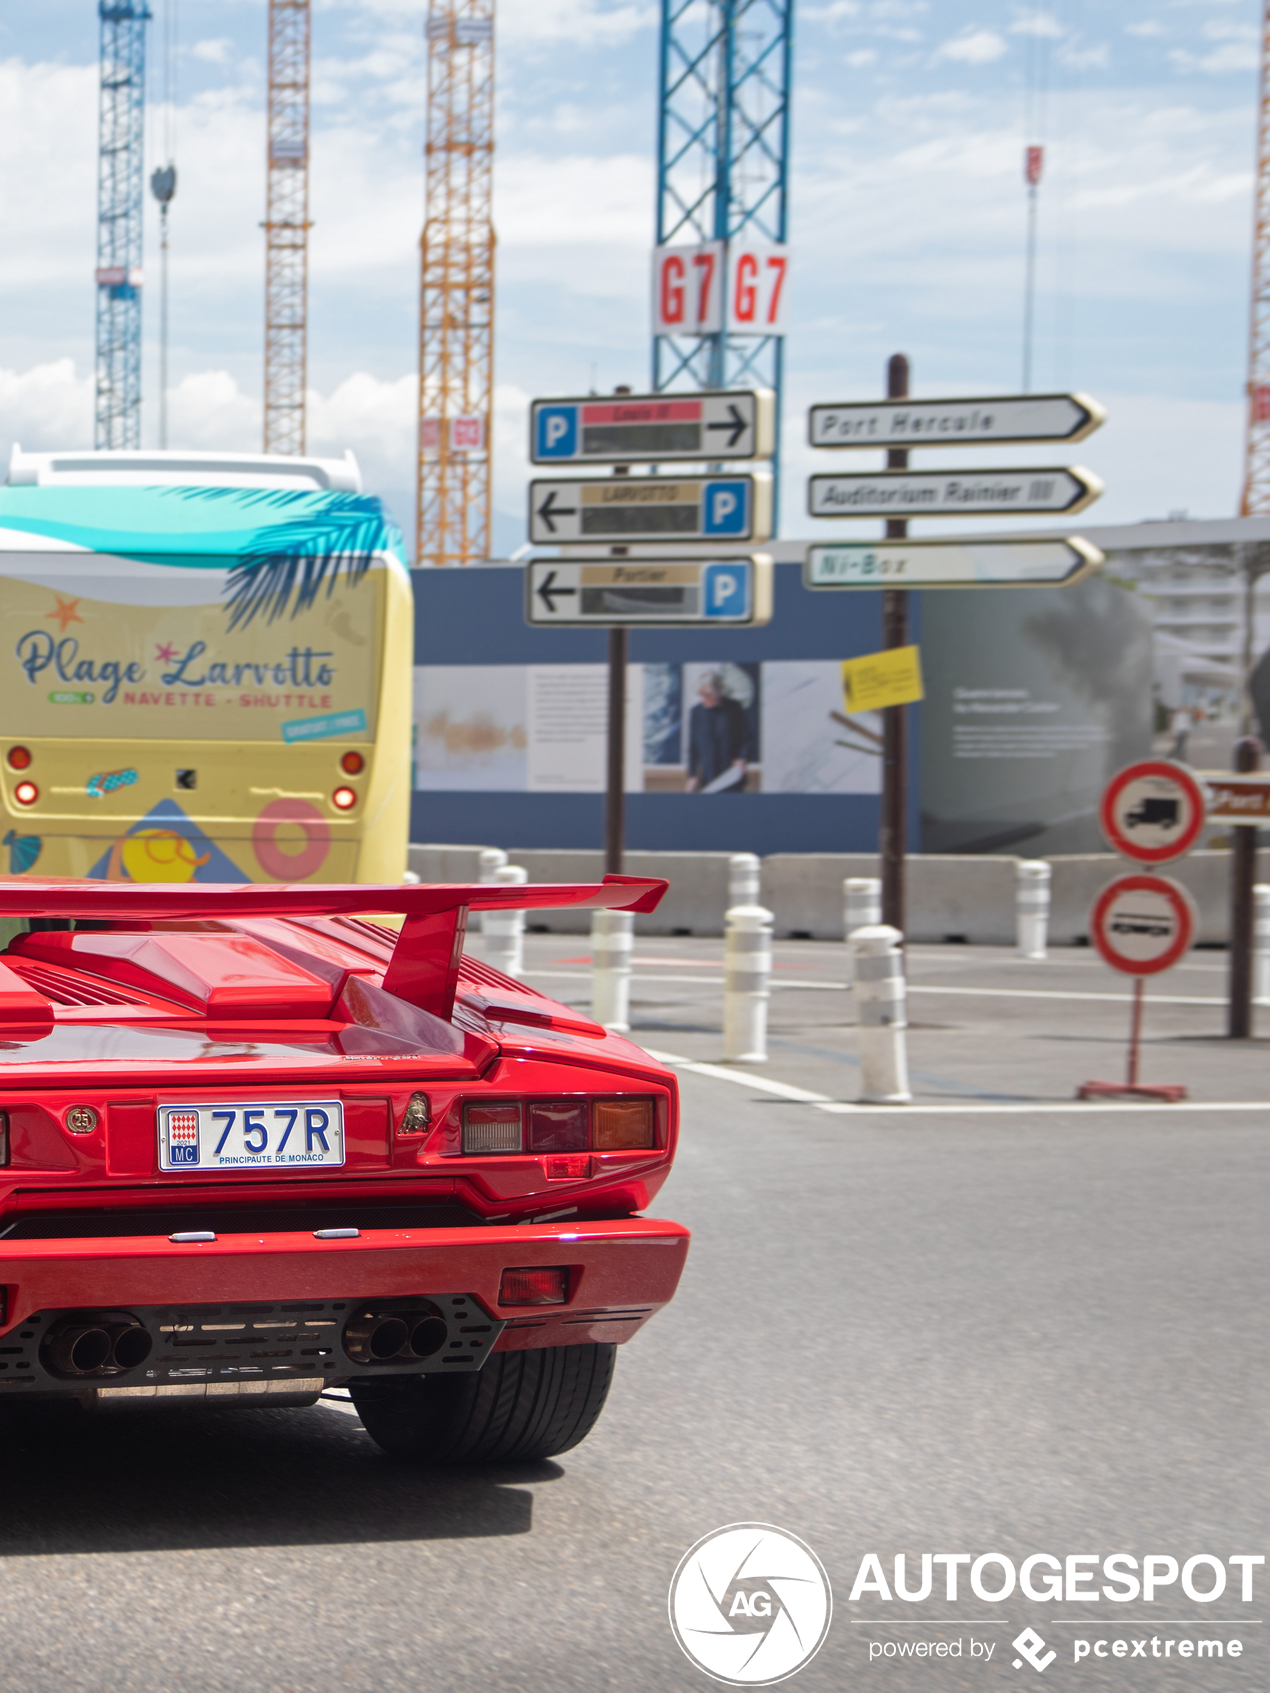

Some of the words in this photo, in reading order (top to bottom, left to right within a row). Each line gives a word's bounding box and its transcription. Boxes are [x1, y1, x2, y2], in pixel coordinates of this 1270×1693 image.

[660, 253, 716, 325] G7
[734, 253, 787, 325] G7
[546, 415, 569, 449] P
[821, 415, 878, 436] Port
[889, 411, 995, 434] Hercule
[712, 491, 737, 525] P
[821, 483, 938, 506] Auditorium
[943, 481, 1022, 502] Rainier
[820, 554, 909, 576] Ni-Box
[712, 574, 737, 607] P
[16, 630, 148, 705] Plage
[160, 641, 337, 689] Larvotto
[124, 691, 216, 707] NAVETTE
[239, 694, 332, 709] SHUTTLE
[74, 1113, 88, 1126] 25
[212, 1108, 330, 1155] 757R
[175, 1148, 194, 1162] MC
[219, 1155, 272, 1165] PRINCIPAUTE
[275, 1155, 286, 1163] DE
[288, 1153, 324, 1162] MONACO
